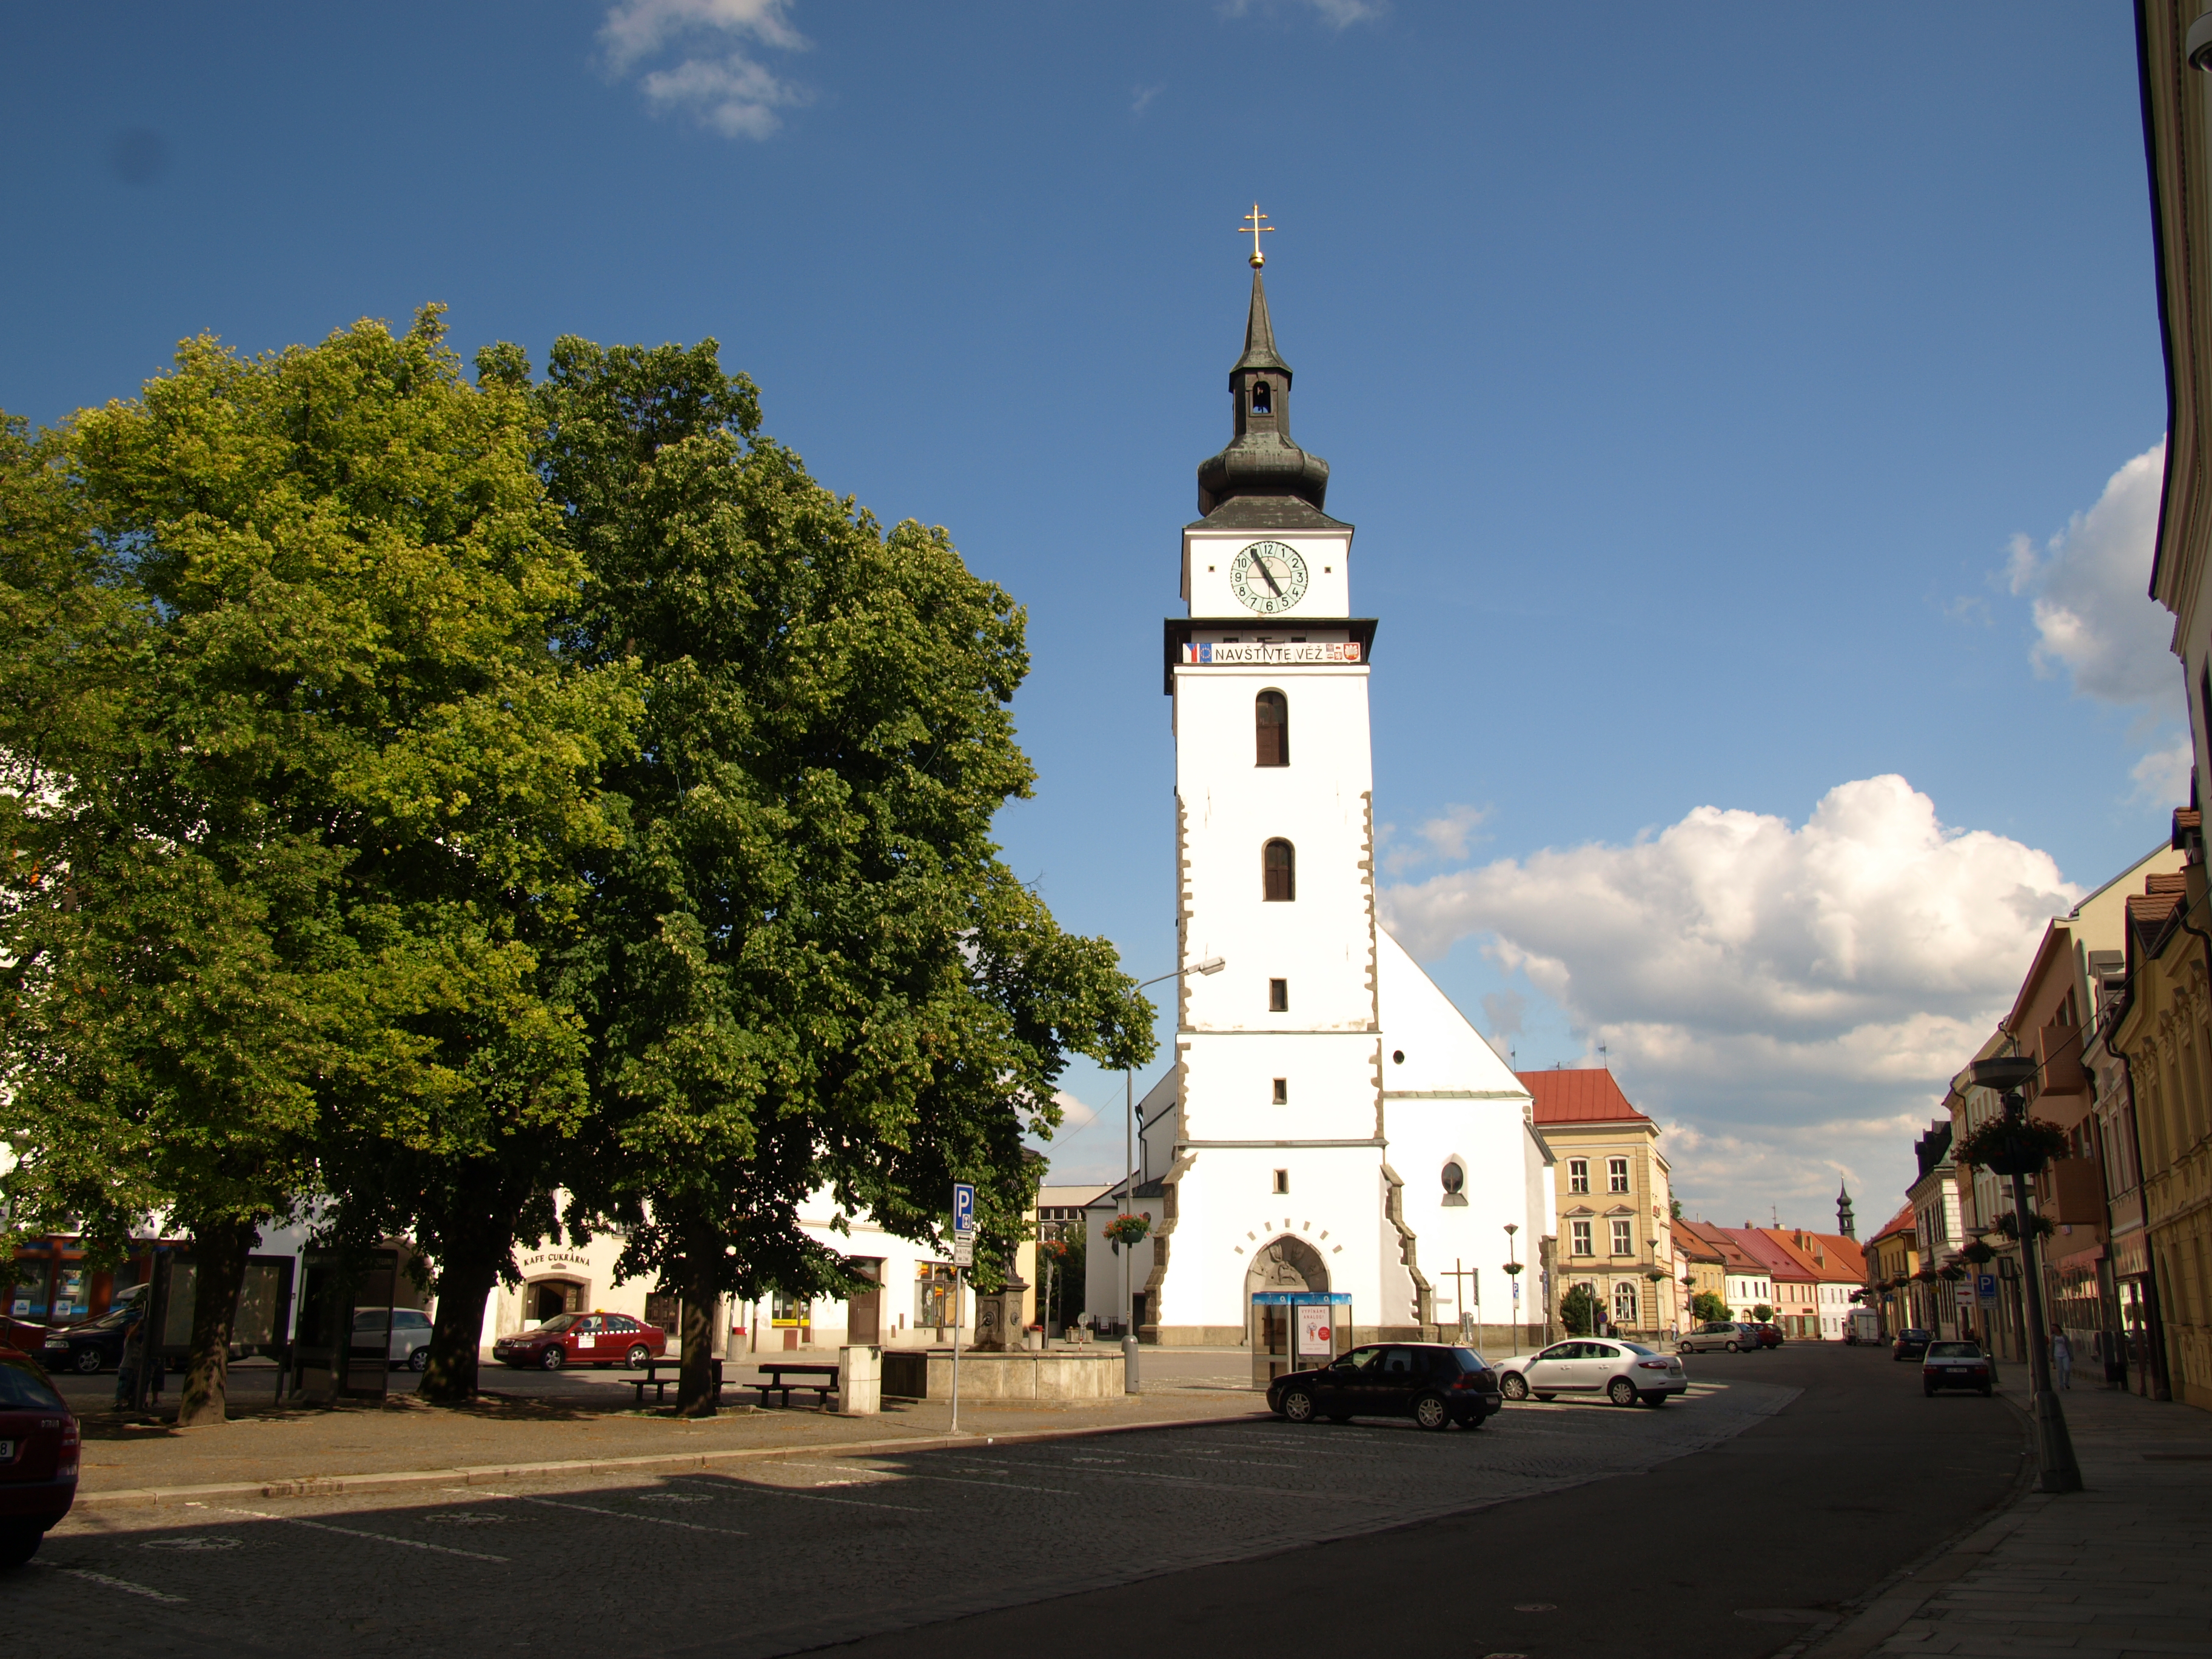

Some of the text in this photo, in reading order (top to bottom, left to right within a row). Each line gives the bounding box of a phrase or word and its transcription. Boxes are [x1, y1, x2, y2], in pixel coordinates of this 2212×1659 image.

[1264, 545, 1273, 554] 12
[1281, 548, 1285, 558] 1
[1238, 558, 1247, 568] 10
[1292, 558, 1299, 568] 2
[1235, 572, 1242, 582] 9
[1296, 572, 1303, 583] 3
[1239, 587, 1246, 597] 8
[1292, 587, 1299, 597] 4
[1251, 598, 1257, 607] 7
[1266, 601, 1273, 611] 6
[1282, 597, 1289, 607] 5
[1216, 645, 1323, 660] NAVŠTIVTE VĚŽ
[959, 1191, 970, 1217] P
[524, 1252, 590, 1267] KAFE CUKRÁRNA
[1980, 1276, 1991, 1290] P
